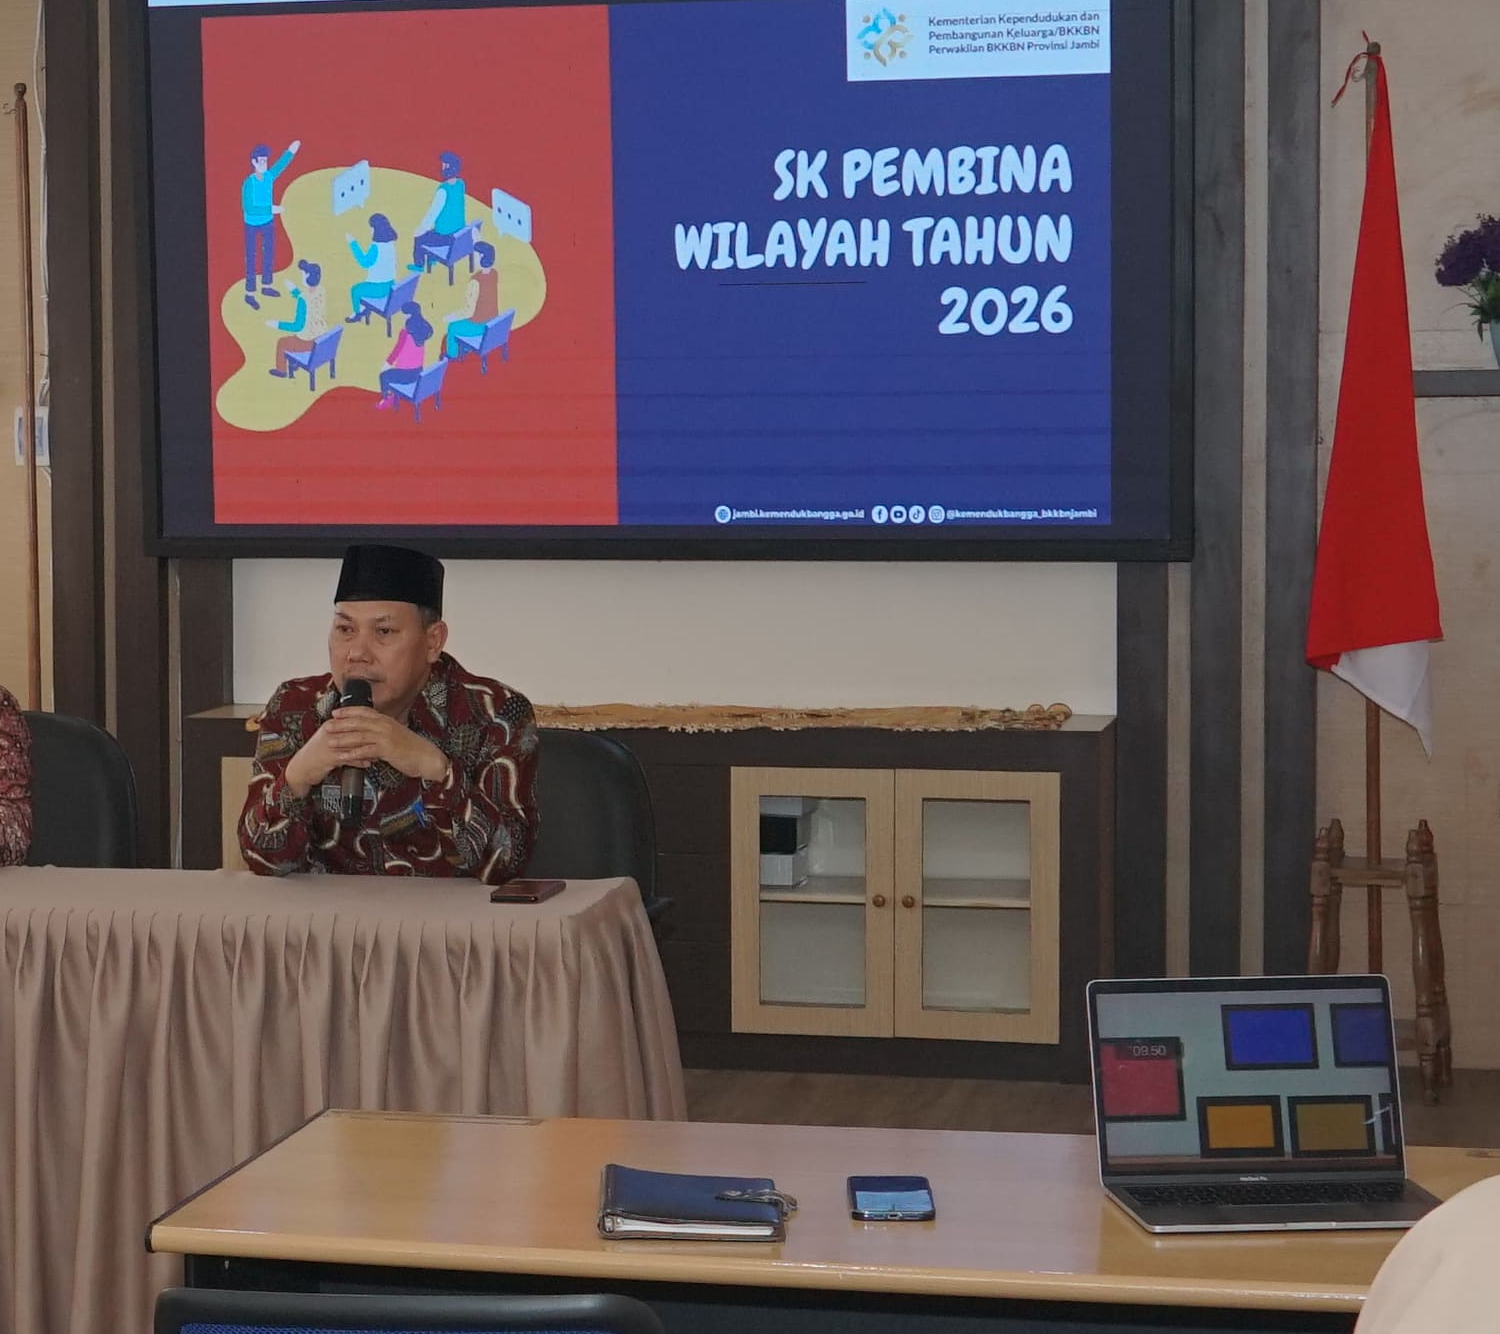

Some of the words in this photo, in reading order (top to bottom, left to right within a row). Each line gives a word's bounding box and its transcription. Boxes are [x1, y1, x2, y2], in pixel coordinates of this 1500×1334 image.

[928, 15, 996, 27] Kementerian
[998, 12, 1078, 25] Kependudukan
[1080, 11, 1100, 22] dan
[928, 29, 1003, 41] Pembangunan
[1006, 25, 1100, 39] Keluarga/BKKBN
[928, 43, 985, 54] Perwakilan
[986, 41, 1025, 53] BKKBN
[1027, 40, 1068, 51] Provinsi
[1070, 39, 1100, 50] Jambi
[773, 148, 829, 201] SK
[842, 144, 1073, 199] PEMBINA
[674, 217, 891, 270] WILAYAH
[902, 214, 1073, 267] TAHUN
[938, 284, 1073, 336] 2026
[732, 508, 864, 520] jambi.kemendukbangga.go.id
[946, 508, 1097, 520] @kemendukbangga_bkkbnjambi
